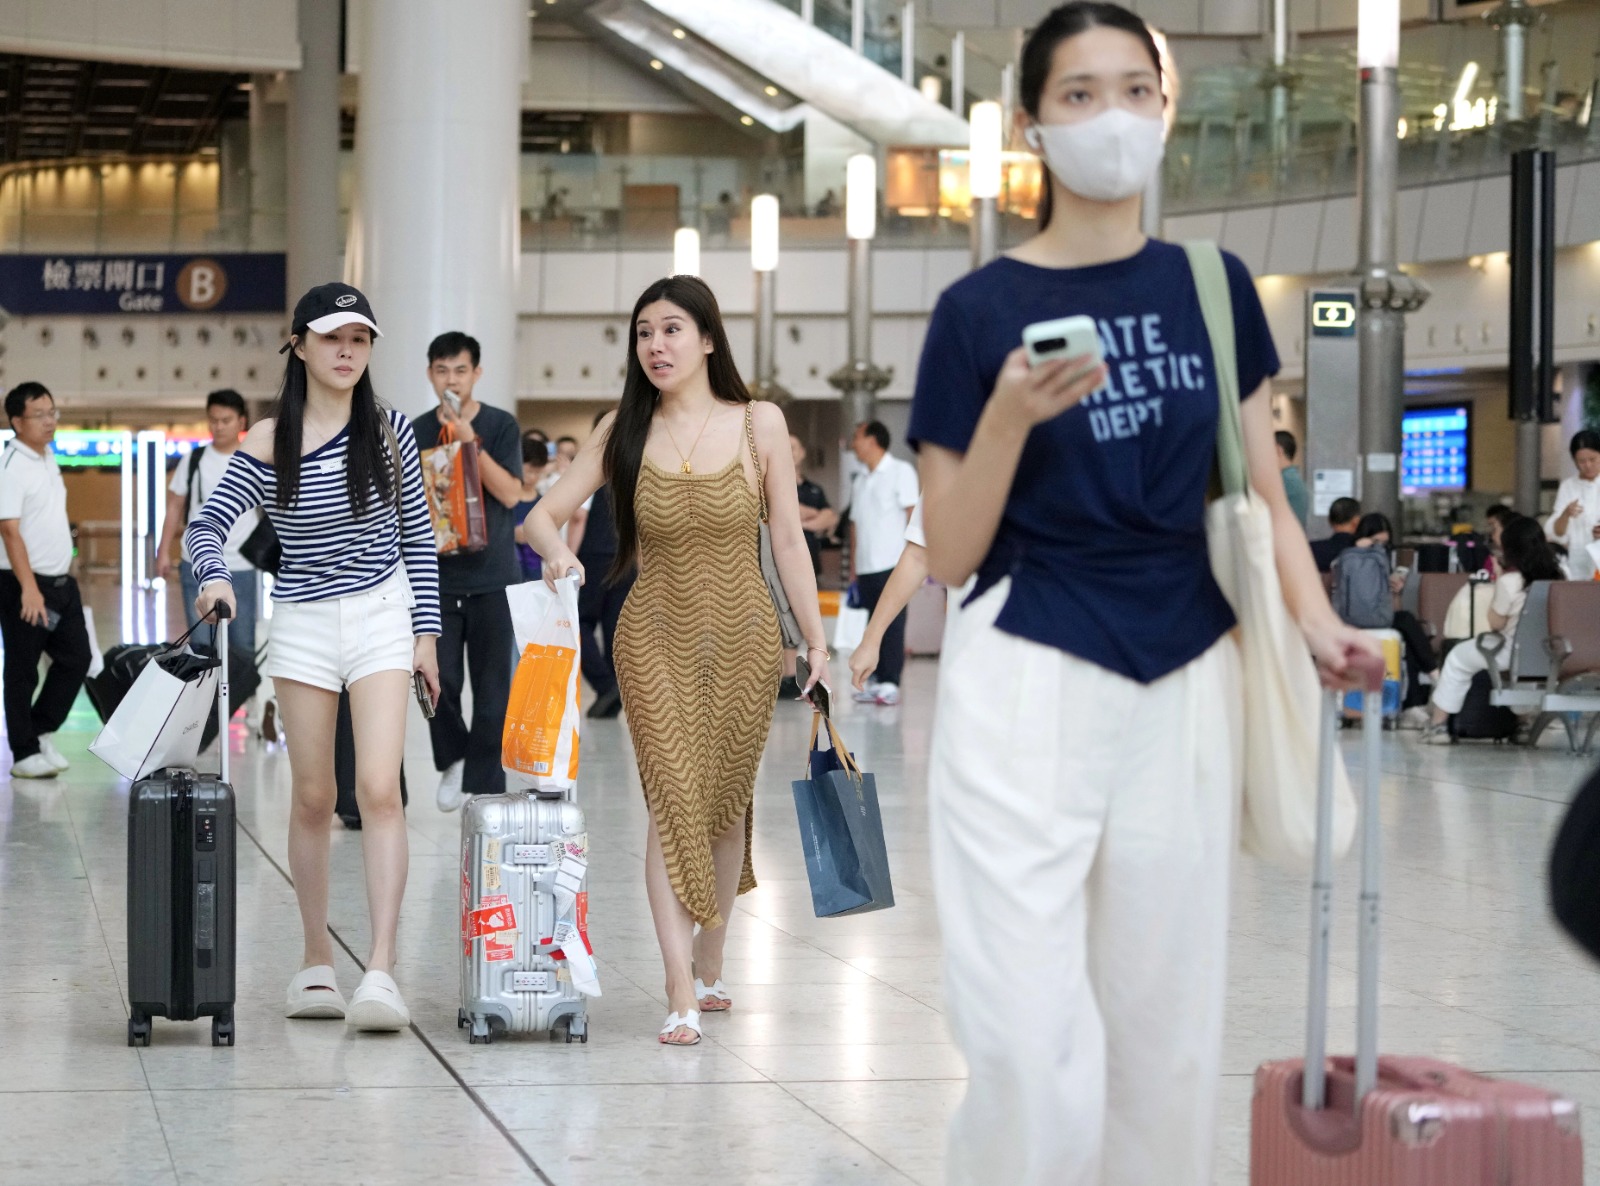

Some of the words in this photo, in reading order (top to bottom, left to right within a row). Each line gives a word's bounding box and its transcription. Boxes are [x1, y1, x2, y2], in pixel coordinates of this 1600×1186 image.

[119, 291, 164, 312] Gate
[189, 266, 216, 303] B
[1098, 314, 1167, 359] ATE
[1081, 353, 1205, 406] LETIC
[1089, 397, 1163, 442] DEPT
